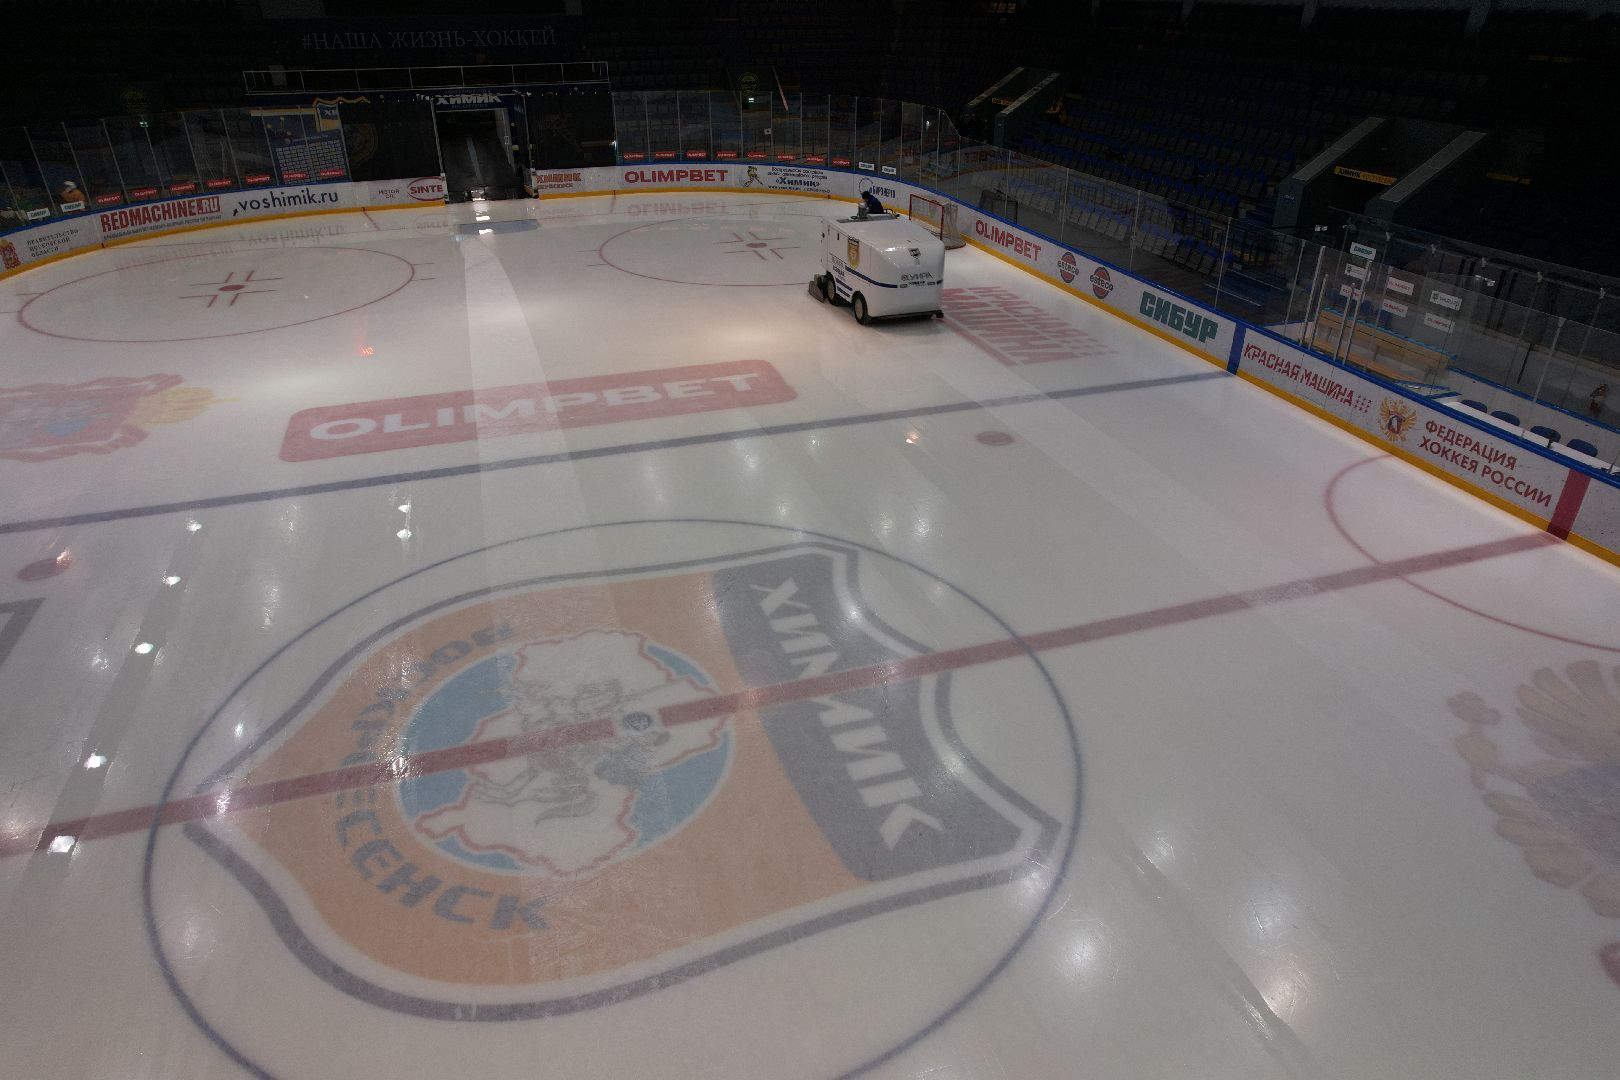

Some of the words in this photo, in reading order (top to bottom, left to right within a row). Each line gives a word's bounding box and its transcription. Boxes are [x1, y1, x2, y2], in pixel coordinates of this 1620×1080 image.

[302, 31, 383, 49] #НАША
[388, 26, 557, 49] ЖИЗНЬ-ХОККЕЙ
[436, 93, 503, 105] ХИМИК
[625, 169, 729, 184] OLIMPBET
[100, 196, 221, 233] REDMACHINE.RU
[238, 188, 338, 210] voshimik.ru
[975, 219, 1042, 262] OLIMPBET
[1057, 259, 1080, 276] esteco
[1089, 274, 1114, 293] esteco
[1139, 291, 1219, 344] СИБУР
[1243, 343, 1301, 380] КРАСНАЯ
[1300, 368, 1354, 407] МАШИНА
[309, 373, 759, 441] OLIMPBET
[1425, 420, 1517, 471] ФЕДЕРАЦИЯ
[1419, 435, 1478, 474] ХОККЕЯ
[1481, 465, 1552, 508] РОССИИ
